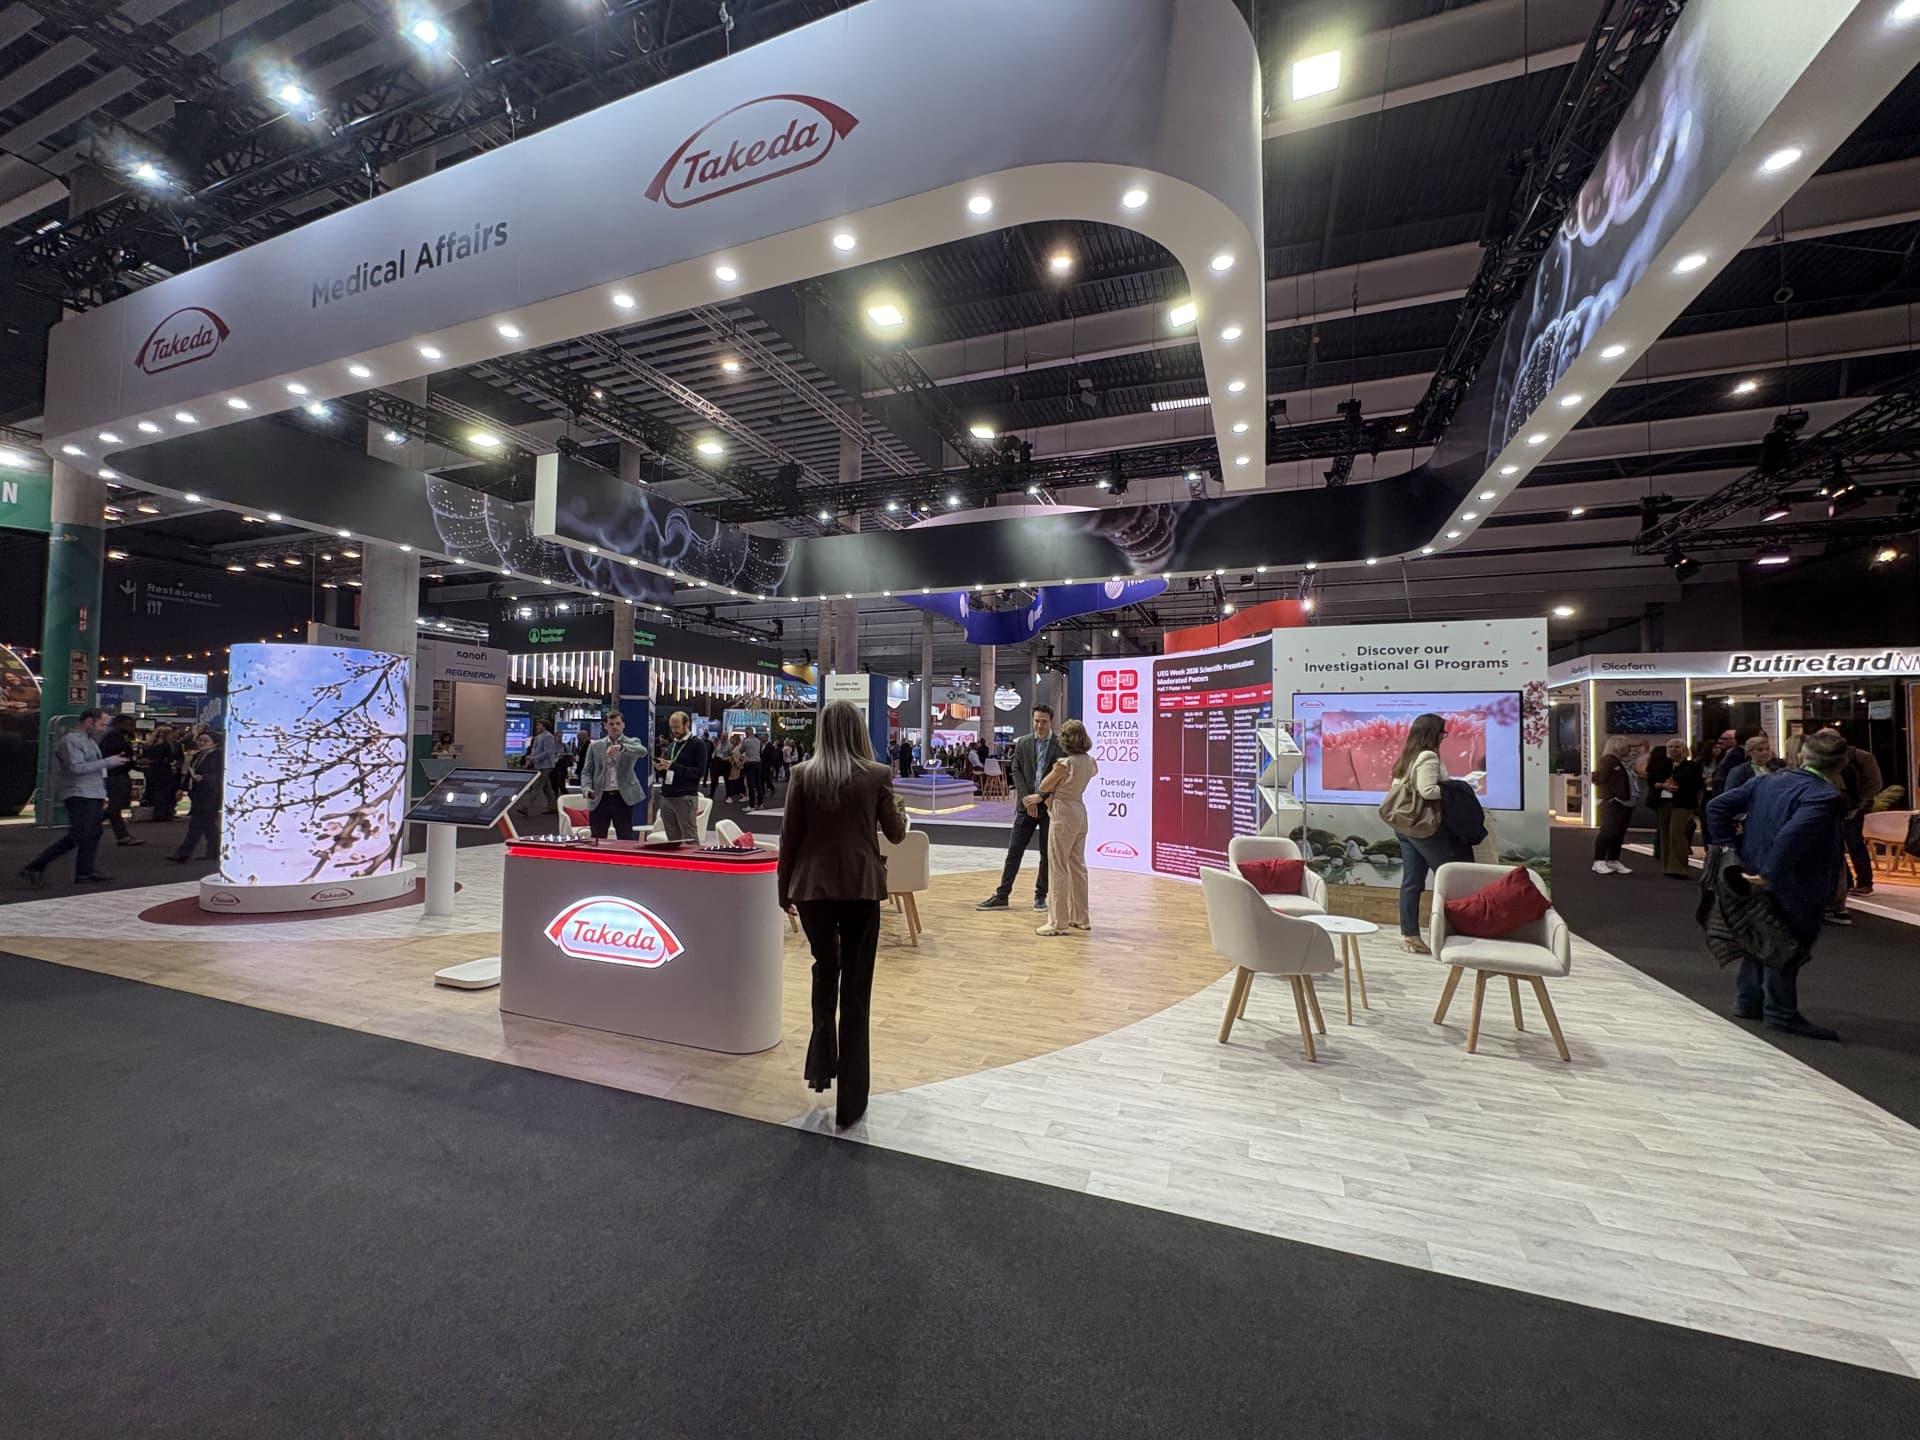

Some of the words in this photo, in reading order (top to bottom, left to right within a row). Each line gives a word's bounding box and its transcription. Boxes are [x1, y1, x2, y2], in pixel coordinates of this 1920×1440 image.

[683, 118, 820, 190] Takeda
[311, 249, 405, 308] Medical
[415, 222, 508, 274] Affairs
[151, 324, 213, 363] Takeda
[146, 583, 212, 601] Restaurant
[456, 650, 487, 661] sanofi
[1357, 645, 1420, 656] Discover
[1424, 645, 1449, 655] our
[1305, 660, 1409, 673] Investigational
[1414, 660, 1429, 670] GI
[1435, 658, 1509, 670] Programs
[1731, 652, 1893, 673] Butiretard
[445, 668, 496, 680] REGENERON
[1097, 721, 1139, 730] TAKEDA
[1096, 746, 1139, 762] 2026
[1101, 777, 1136, 789] Tuesday
[1100, 789, 1135, 799] October
[1108, 802, 1127, 817] 20
[319, 892, 347, 900] Takeda
[573, 920, 656, 951] Takeda
